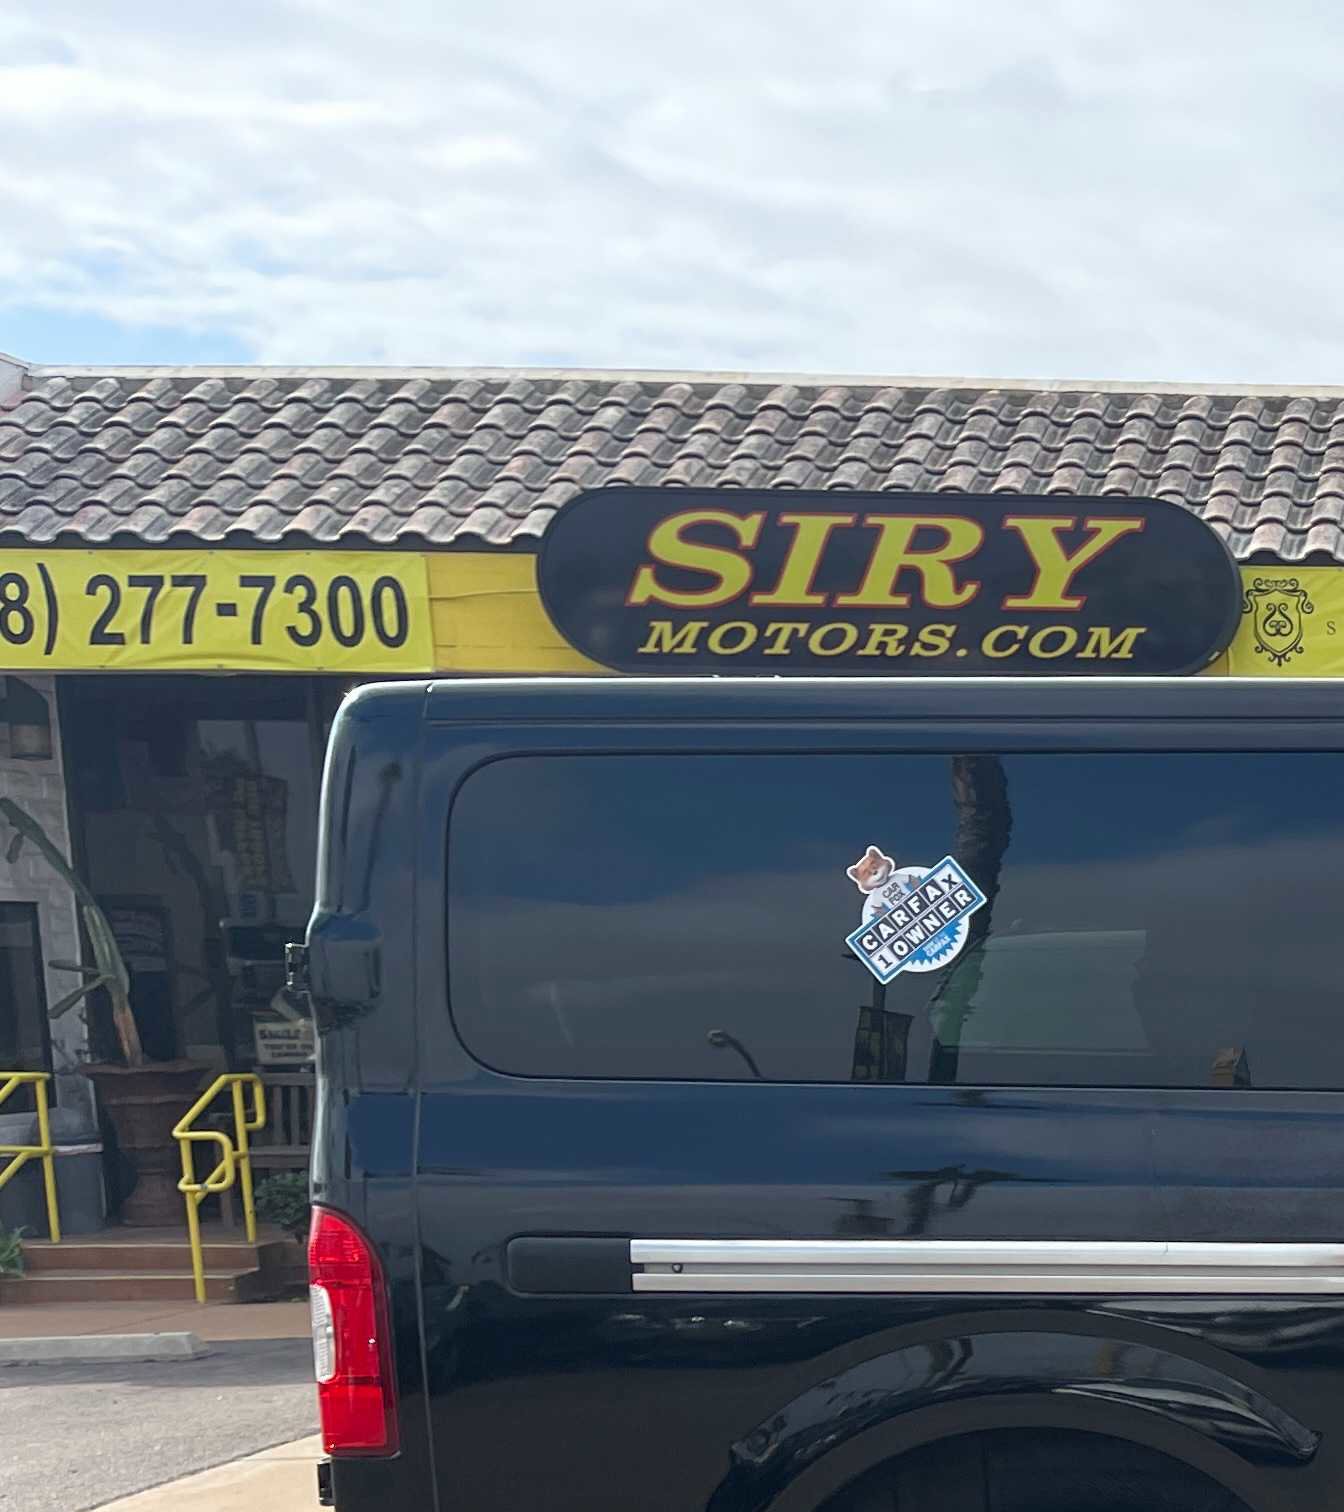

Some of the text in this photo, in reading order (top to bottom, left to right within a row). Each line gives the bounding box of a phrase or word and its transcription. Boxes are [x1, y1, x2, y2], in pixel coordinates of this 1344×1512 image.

[625, 508, 1144, 612] SIRY
[85, 572, 409, 649] 277-7300
[637, 620, 1147, 660] MOTORS.COM
[862, 873, 958, 950] CARFAX
